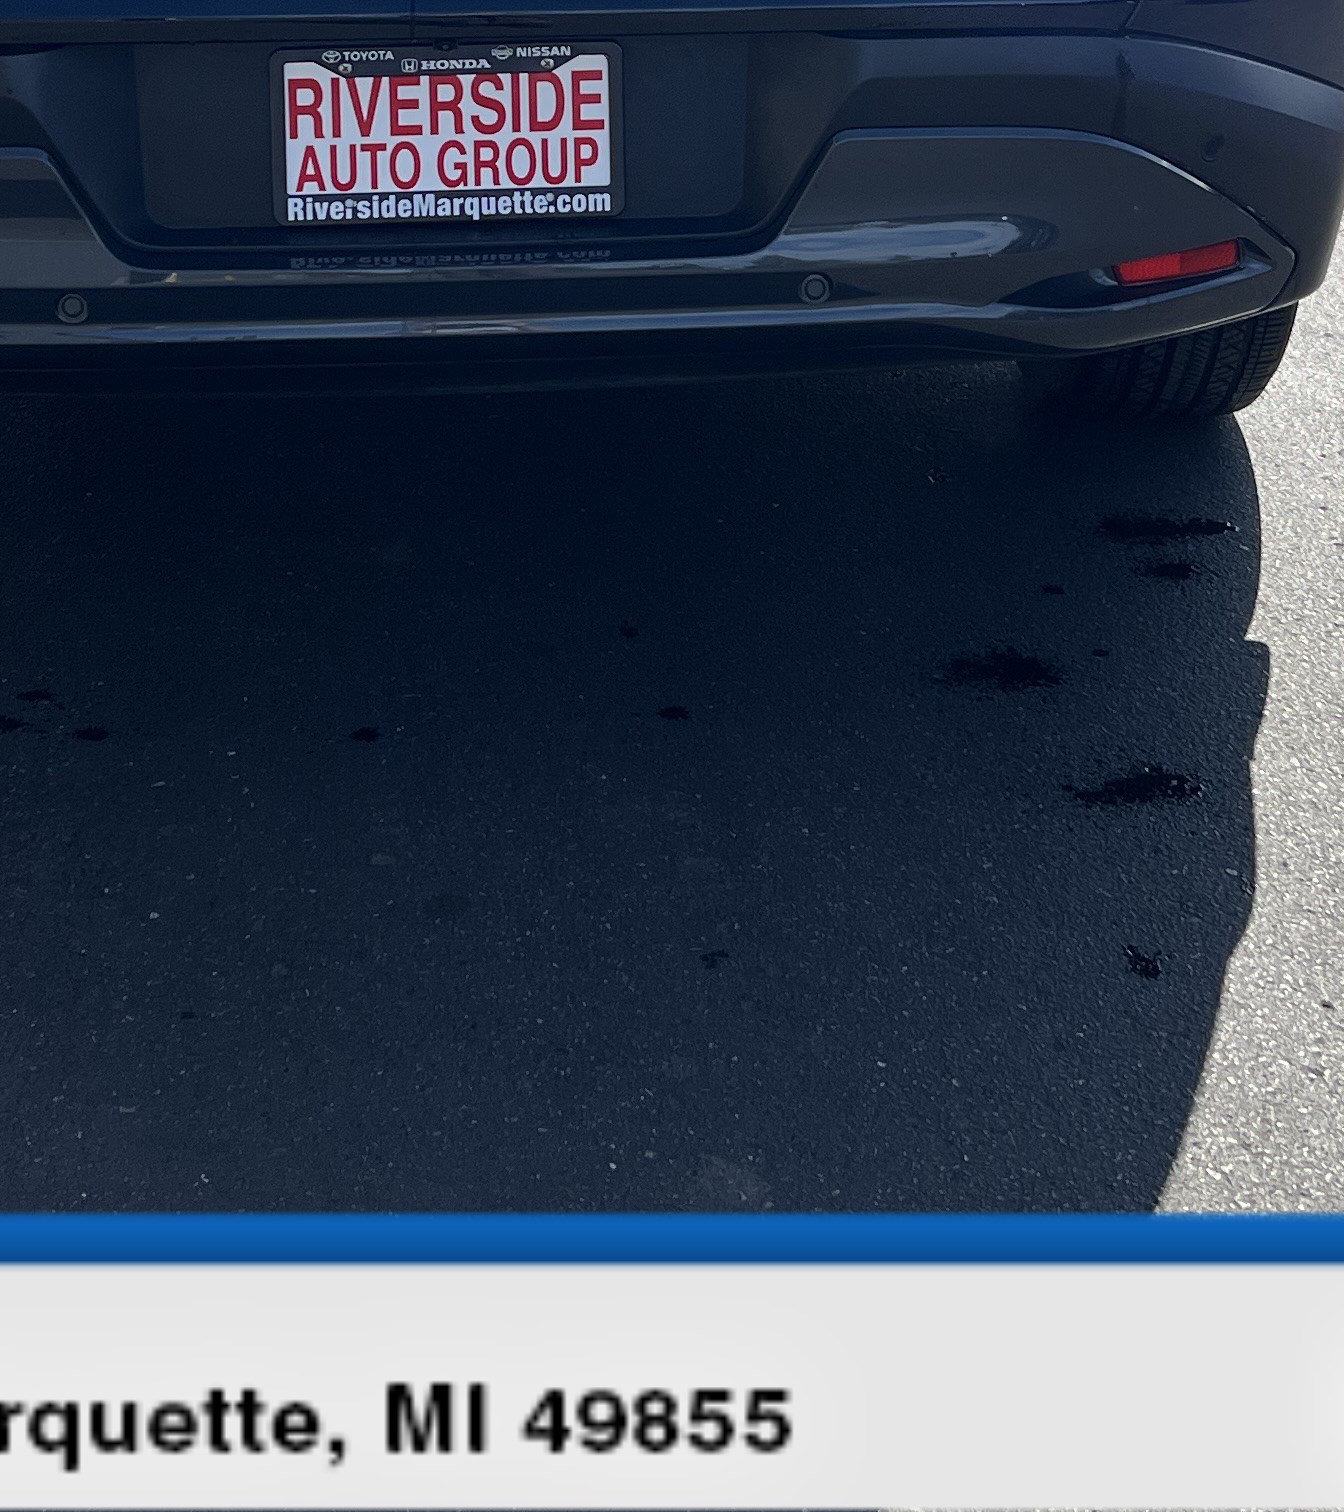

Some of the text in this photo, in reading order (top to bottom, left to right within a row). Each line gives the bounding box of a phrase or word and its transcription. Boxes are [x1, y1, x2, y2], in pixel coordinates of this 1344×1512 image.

[342, 50, 394, 61] TOYOTA
[516, 46, 571, 57] NISSAN
[420, 59, 491, 70] HONDA
[288, 70, 605, 140] RIVERSIDE
[296, 136, 599, 192] AUTO GROUP
[287, 191, 611, 221] RiversideMarquette.com
